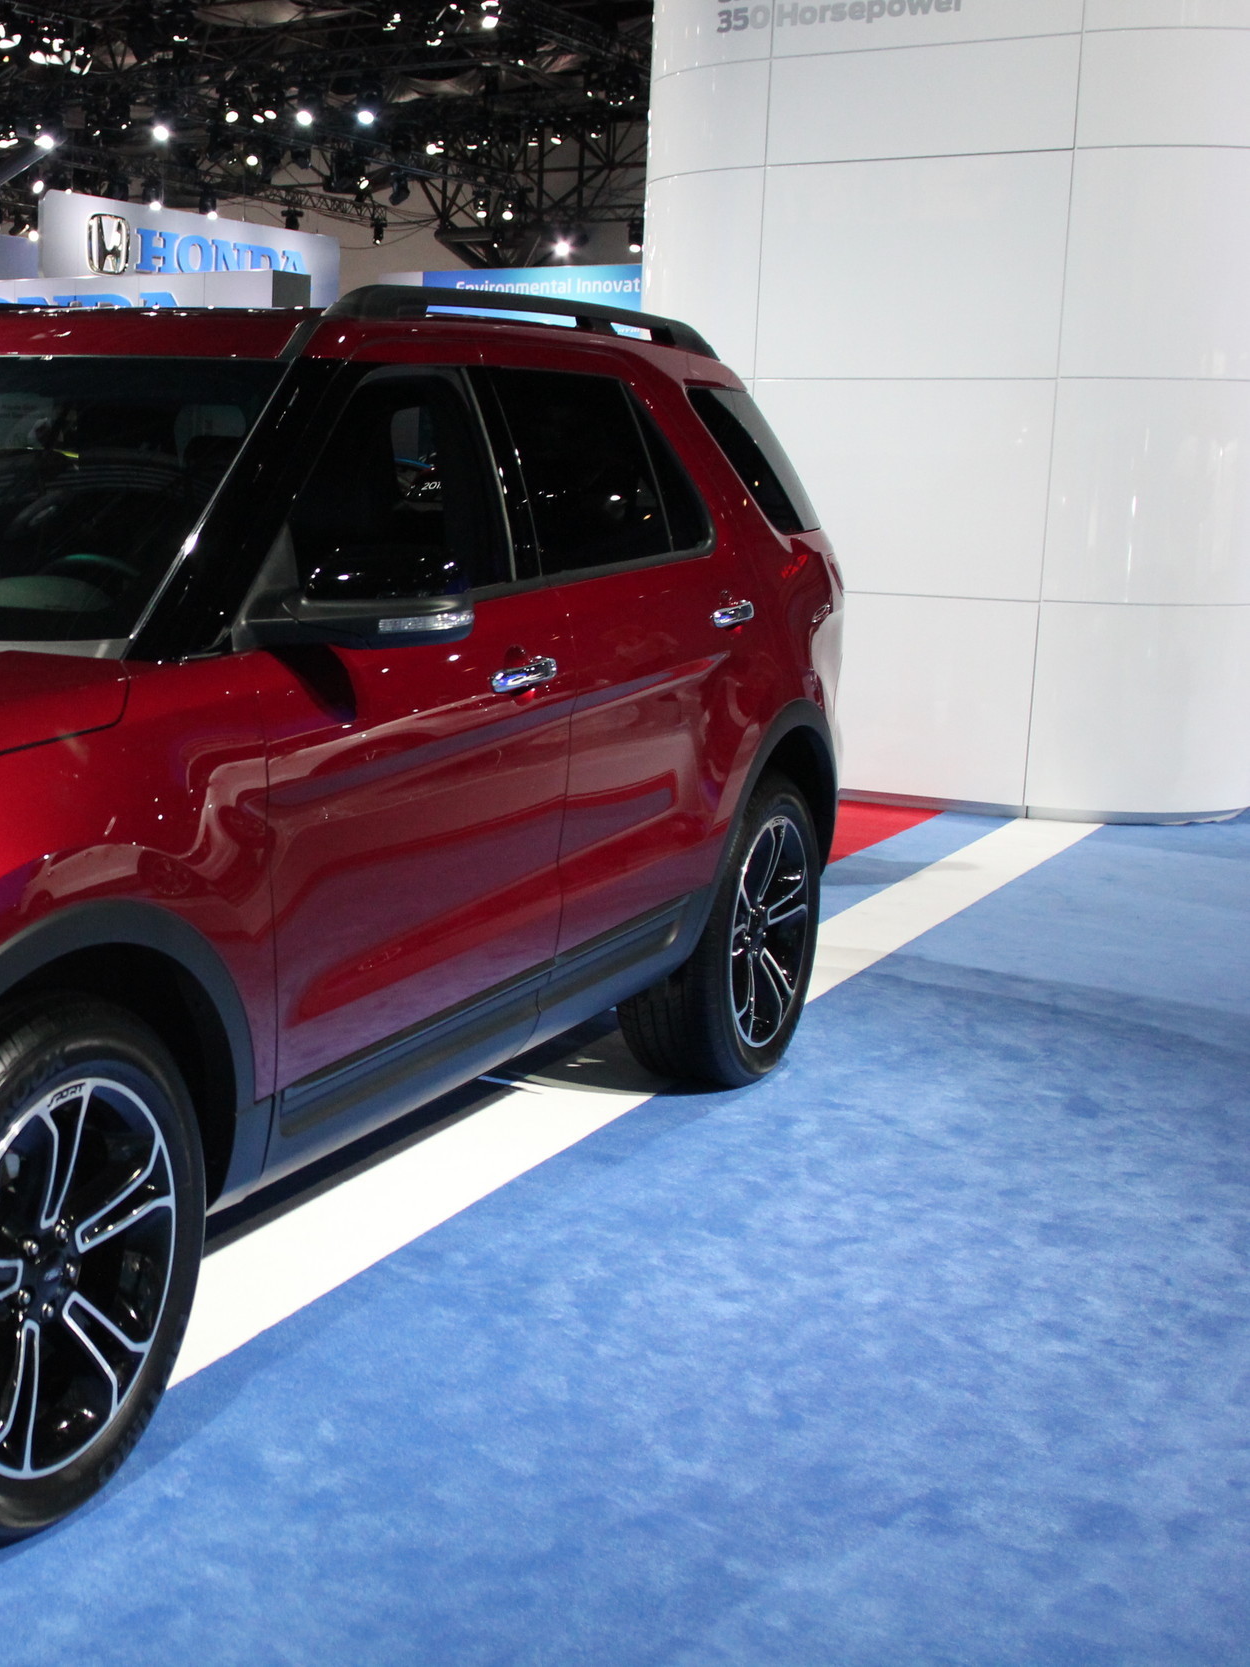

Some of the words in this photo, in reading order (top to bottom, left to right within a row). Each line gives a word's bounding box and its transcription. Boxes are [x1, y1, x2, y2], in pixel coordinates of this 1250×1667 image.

[716, 5, 771, 33] 350
[135, 228, 311, 275] HONDA
[46, 1081, 86, 1108] SPORT
